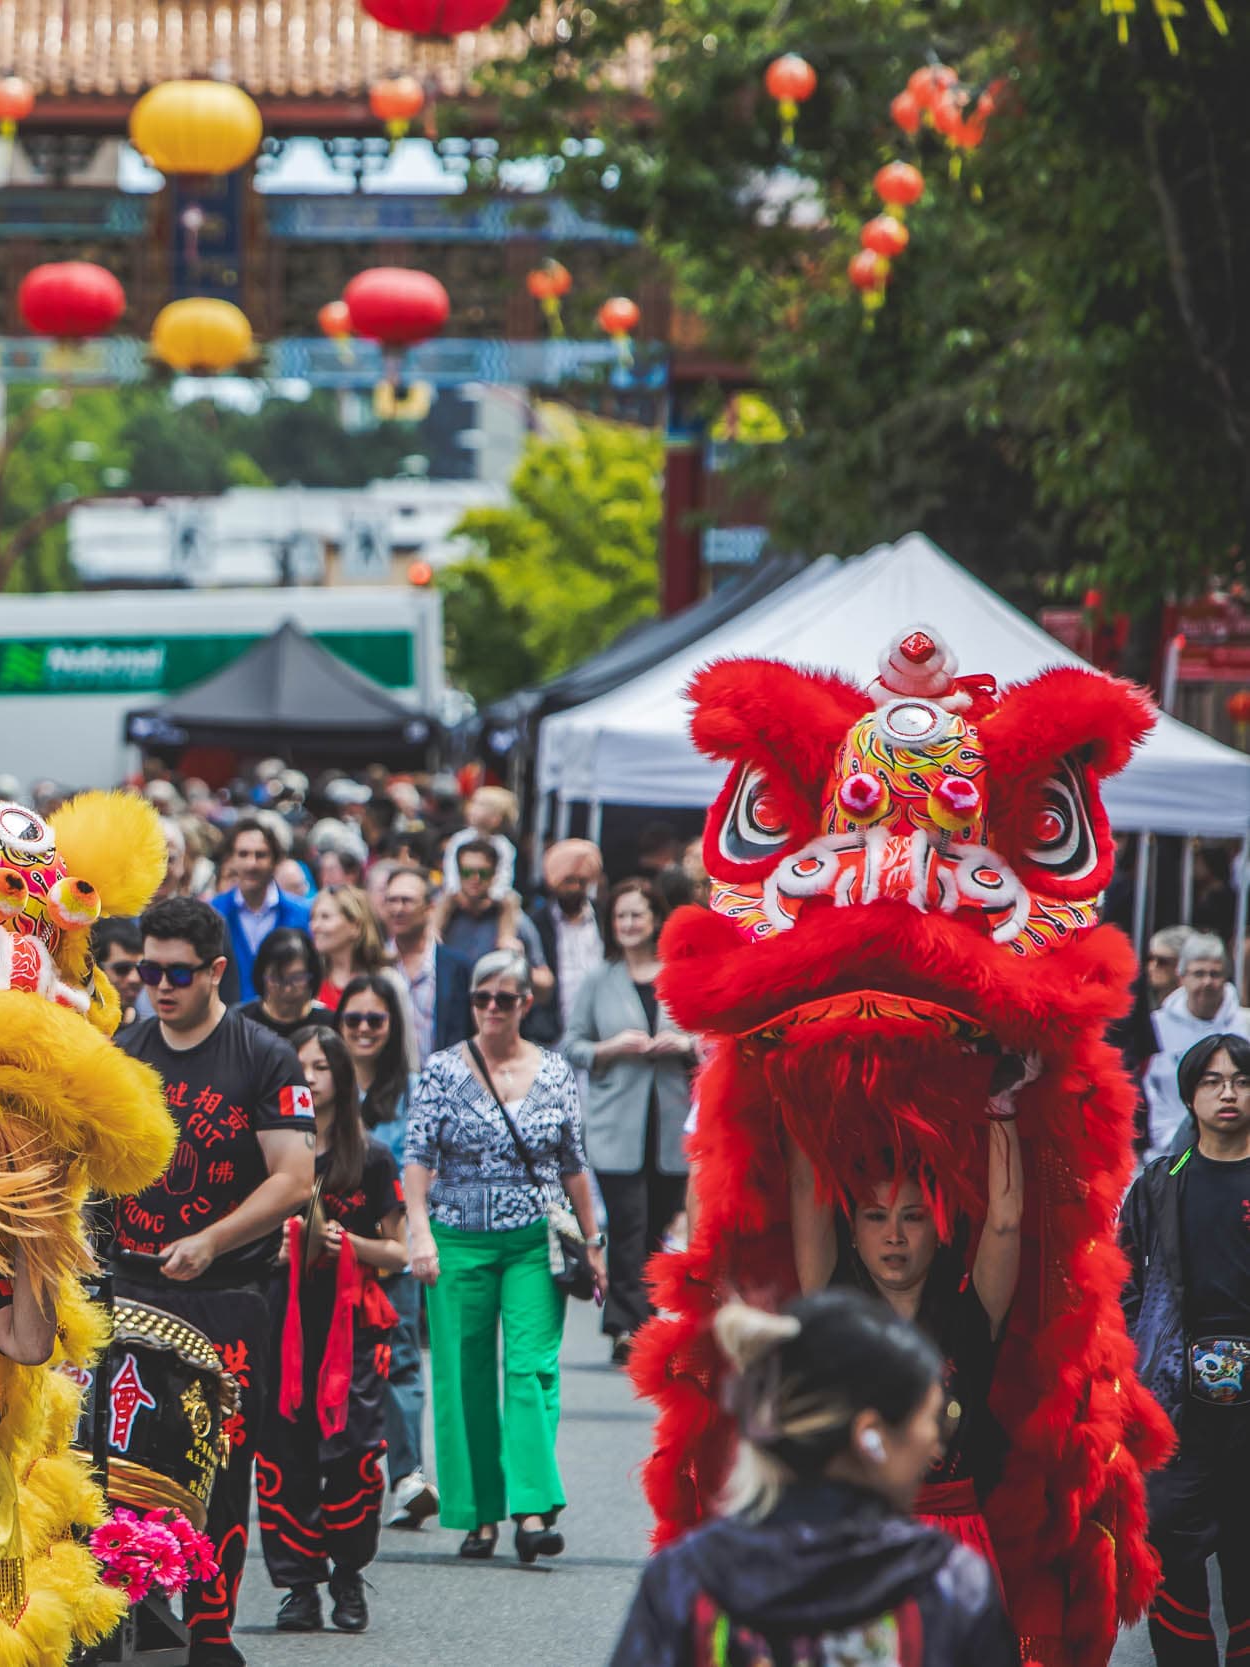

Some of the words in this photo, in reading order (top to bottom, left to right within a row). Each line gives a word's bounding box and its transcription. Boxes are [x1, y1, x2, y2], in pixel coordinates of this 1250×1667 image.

[187, 1113, 225, 1149] FUT
[207, 1160, 234, 1184] 佛
[180, 1197, 212, 1225] FU
